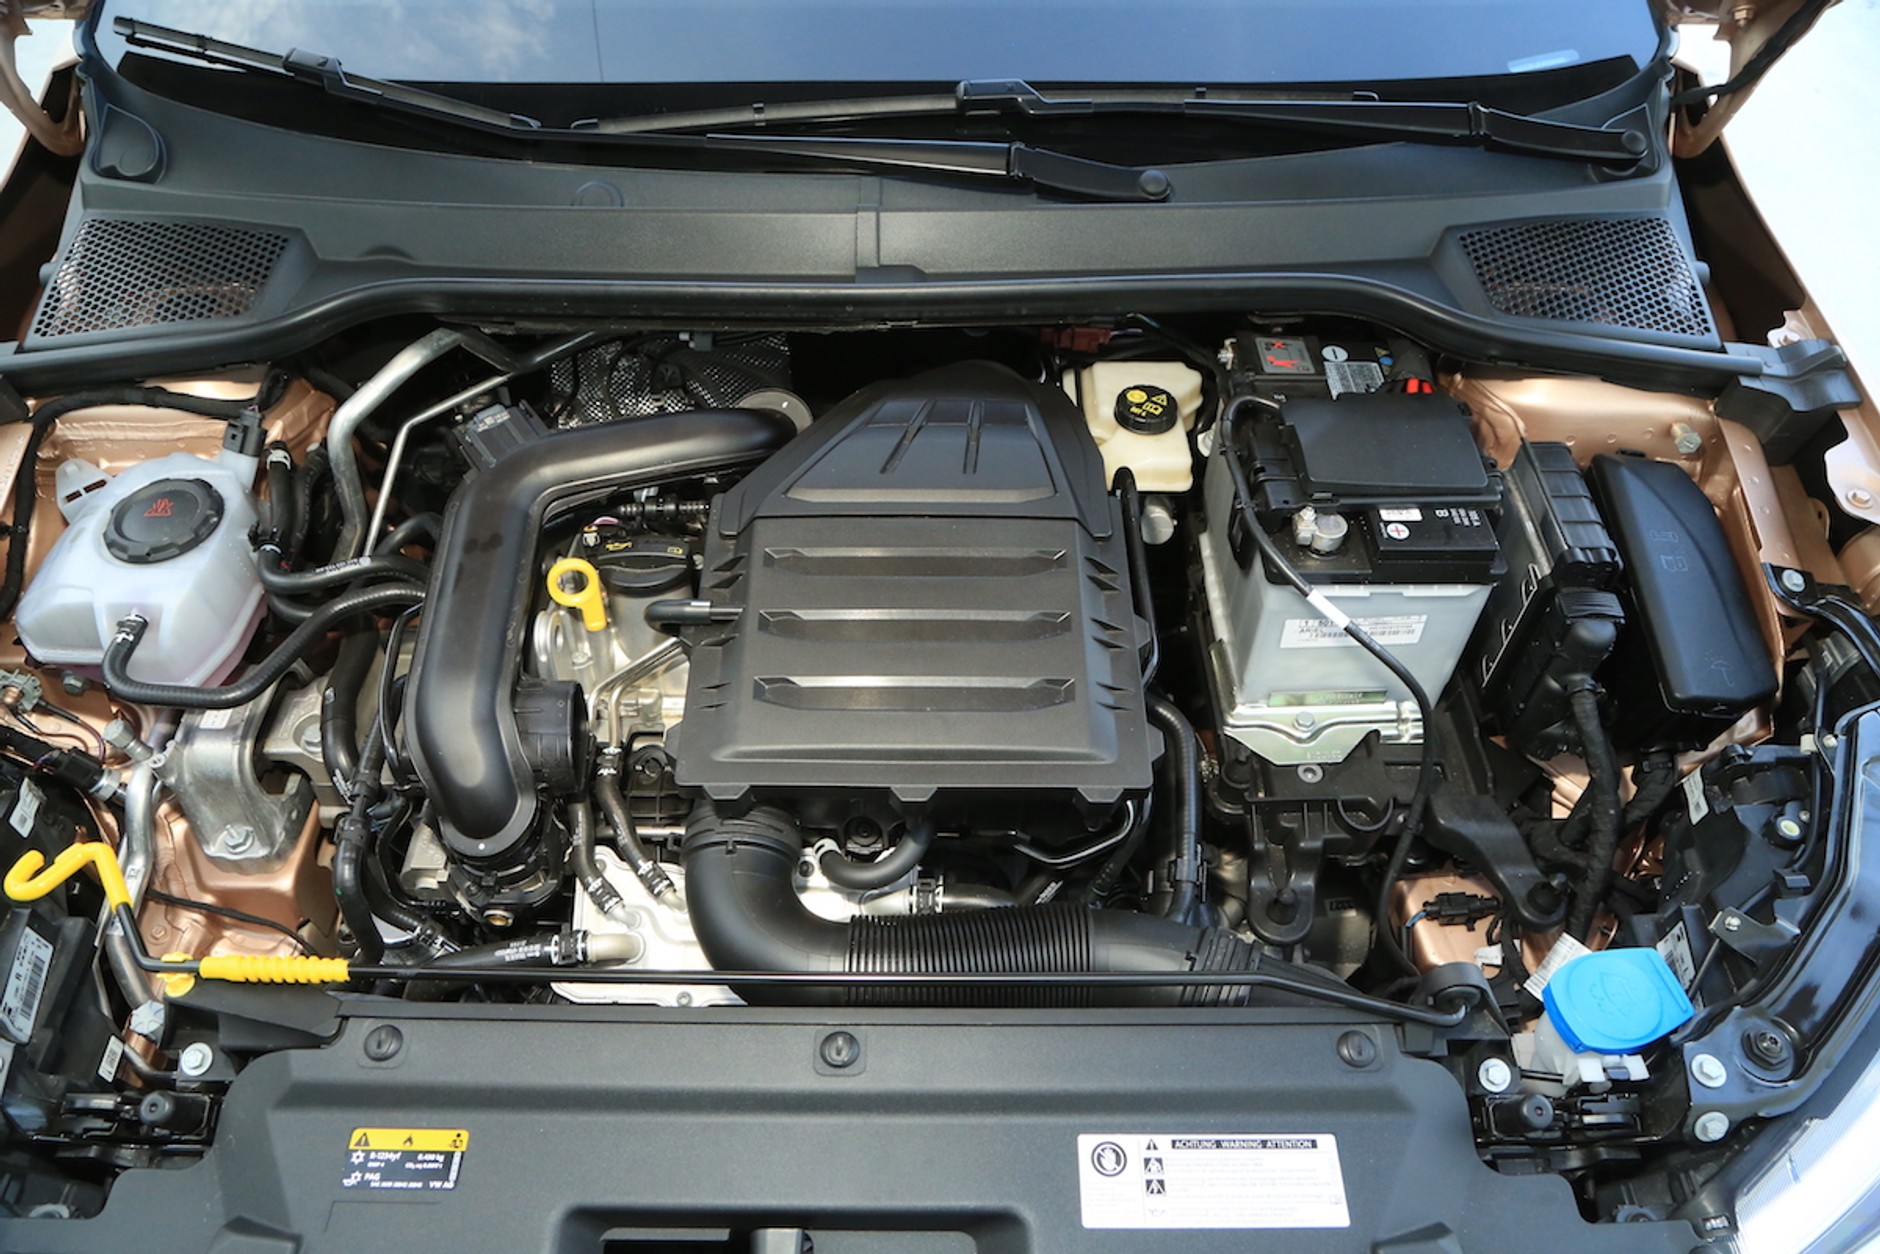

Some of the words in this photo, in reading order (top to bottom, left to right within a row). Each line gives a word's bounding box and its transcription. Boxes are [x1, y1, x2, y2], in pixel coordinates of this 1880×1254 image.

[1175, 1139, 1216, 1149] ACHTUNG
[1220, 1139, 1261, 1149] WARNING
[1266, 1139, 1312, 1149] ATTENTION
[363, 1172, 381, 1181] PAG
[429, 1180, 442, 1188] VW
